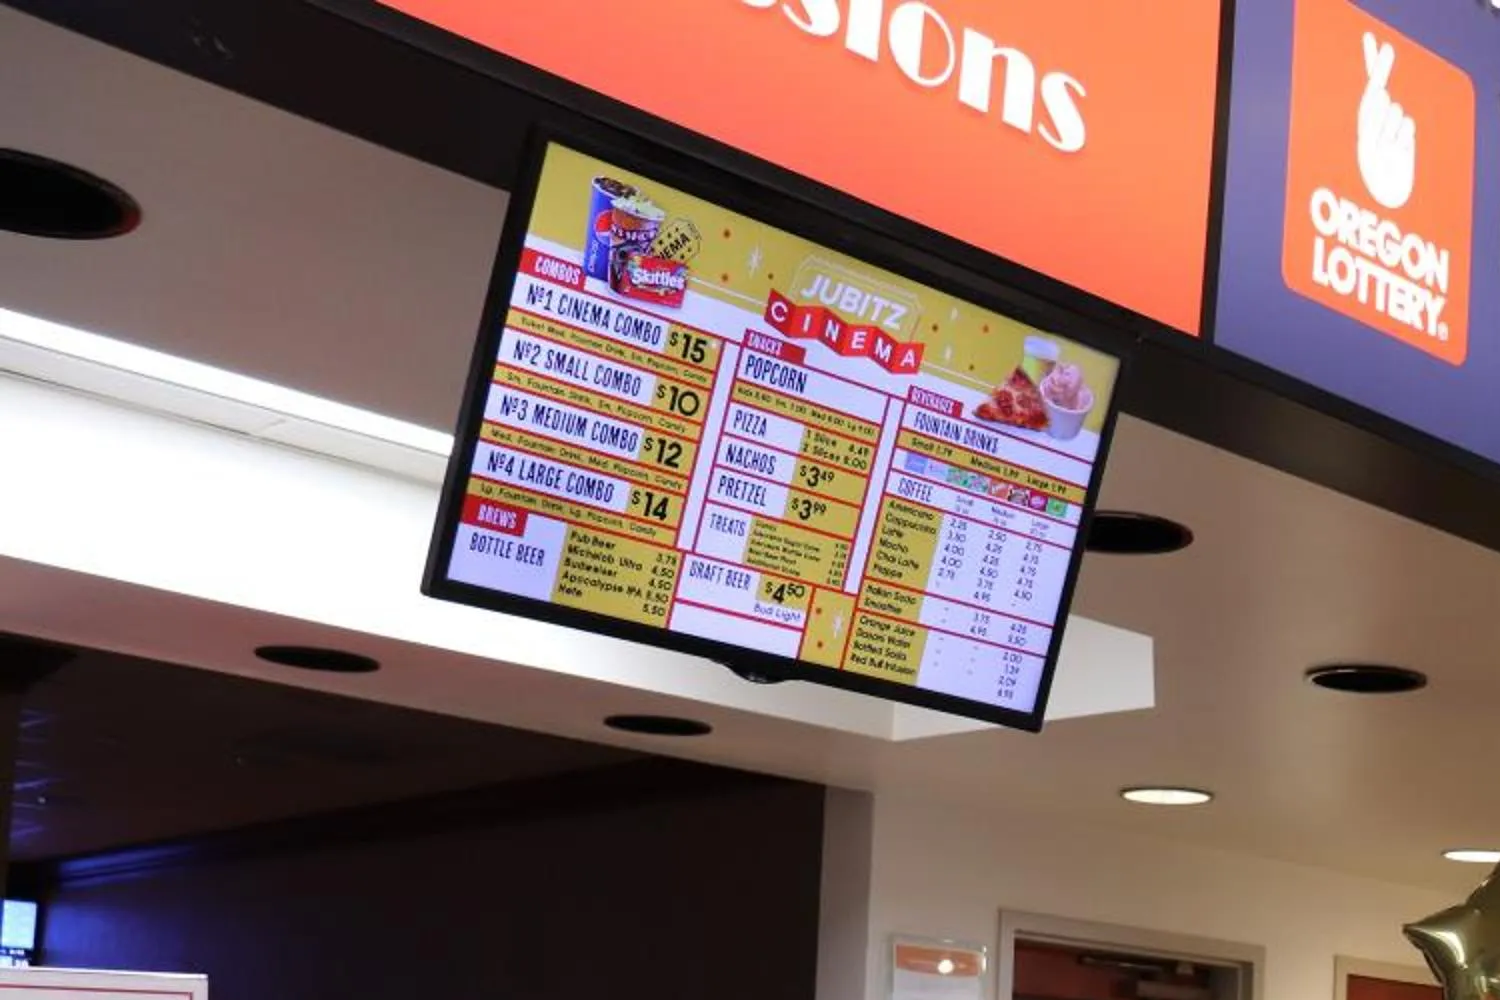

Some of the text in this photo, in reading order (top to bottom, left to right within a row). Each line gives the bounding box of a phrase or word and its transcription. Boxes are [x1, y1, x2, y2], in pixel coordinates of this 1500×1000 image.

[1311, 187, 1449, 294] OREGON
[535, 259, 582, 286] COMBOS
[801, 275, 908, 331] JUBITZ
[557, 294, 610, 330] CINEMA
[613, 312, 661, 345] COMBO
[669, 331, 707, 364] $15
[770, 302, 916, 367] CINEMA
[544, 349, 589, 381] SMALL
[593, 364, 642, 396] COMBO
[656, 384, 700, 416] $10
[745, 354, 808, 393] POPCORN
[532, 403, 588, 438] MEDIUM
[591, 421, 638, 453] COMBO
[644, 437, 682, 468] $12
[734, 409, 767, 437] PIZZA
[915, 411, 962, 442] FOUNTAIN
[726, 443, 776, 475] NACHOS
[518, 459, 565, 490] LARGE
[566, 474, 615, 504] COMBO
[632, 490, 669, 521] $14
[717, 475, 767, 507] PRETZEL
[898, 478, 933, 503] COFFEE
[709, 513, 746, 537] TREATS
[469, 532, 545, 566] BOTTLE BEER
[689, 560, 721, 583] DRAFT
[725, 569, 751, 591] BEER
